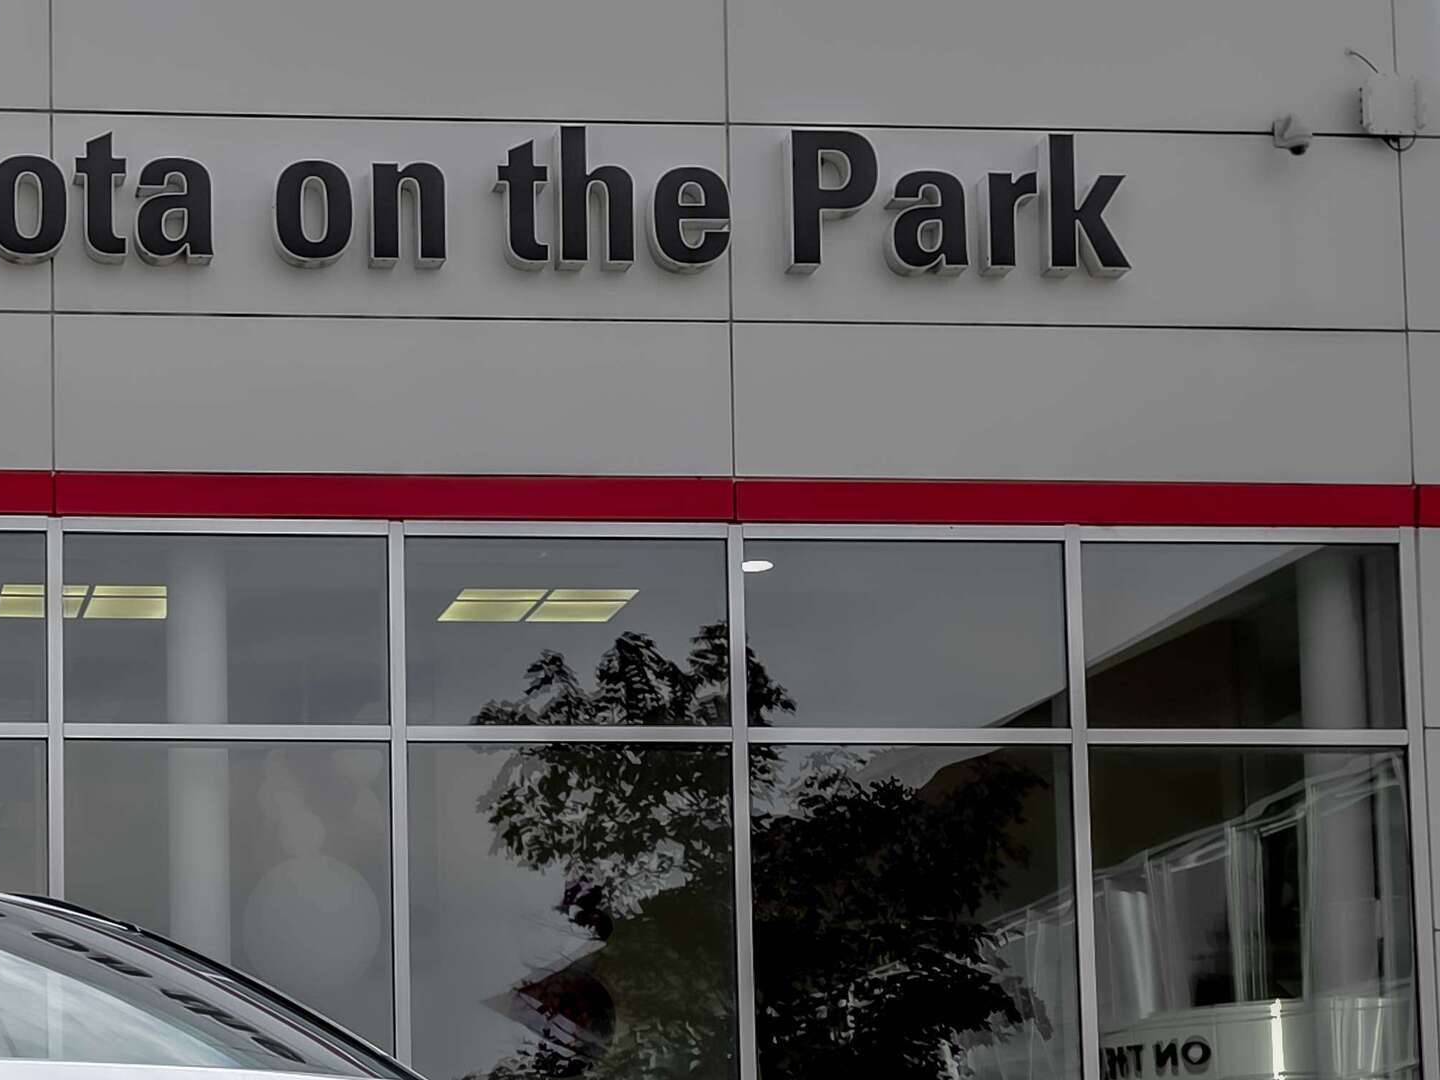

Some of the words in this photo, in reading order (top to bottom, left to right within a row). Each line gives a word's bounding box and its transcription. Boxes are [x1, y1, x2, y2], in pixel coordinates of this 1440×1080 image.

[273, 158, 447, 268] on
[494, 124, 733, 271] the
[784, 128, 1133, 279] Park
